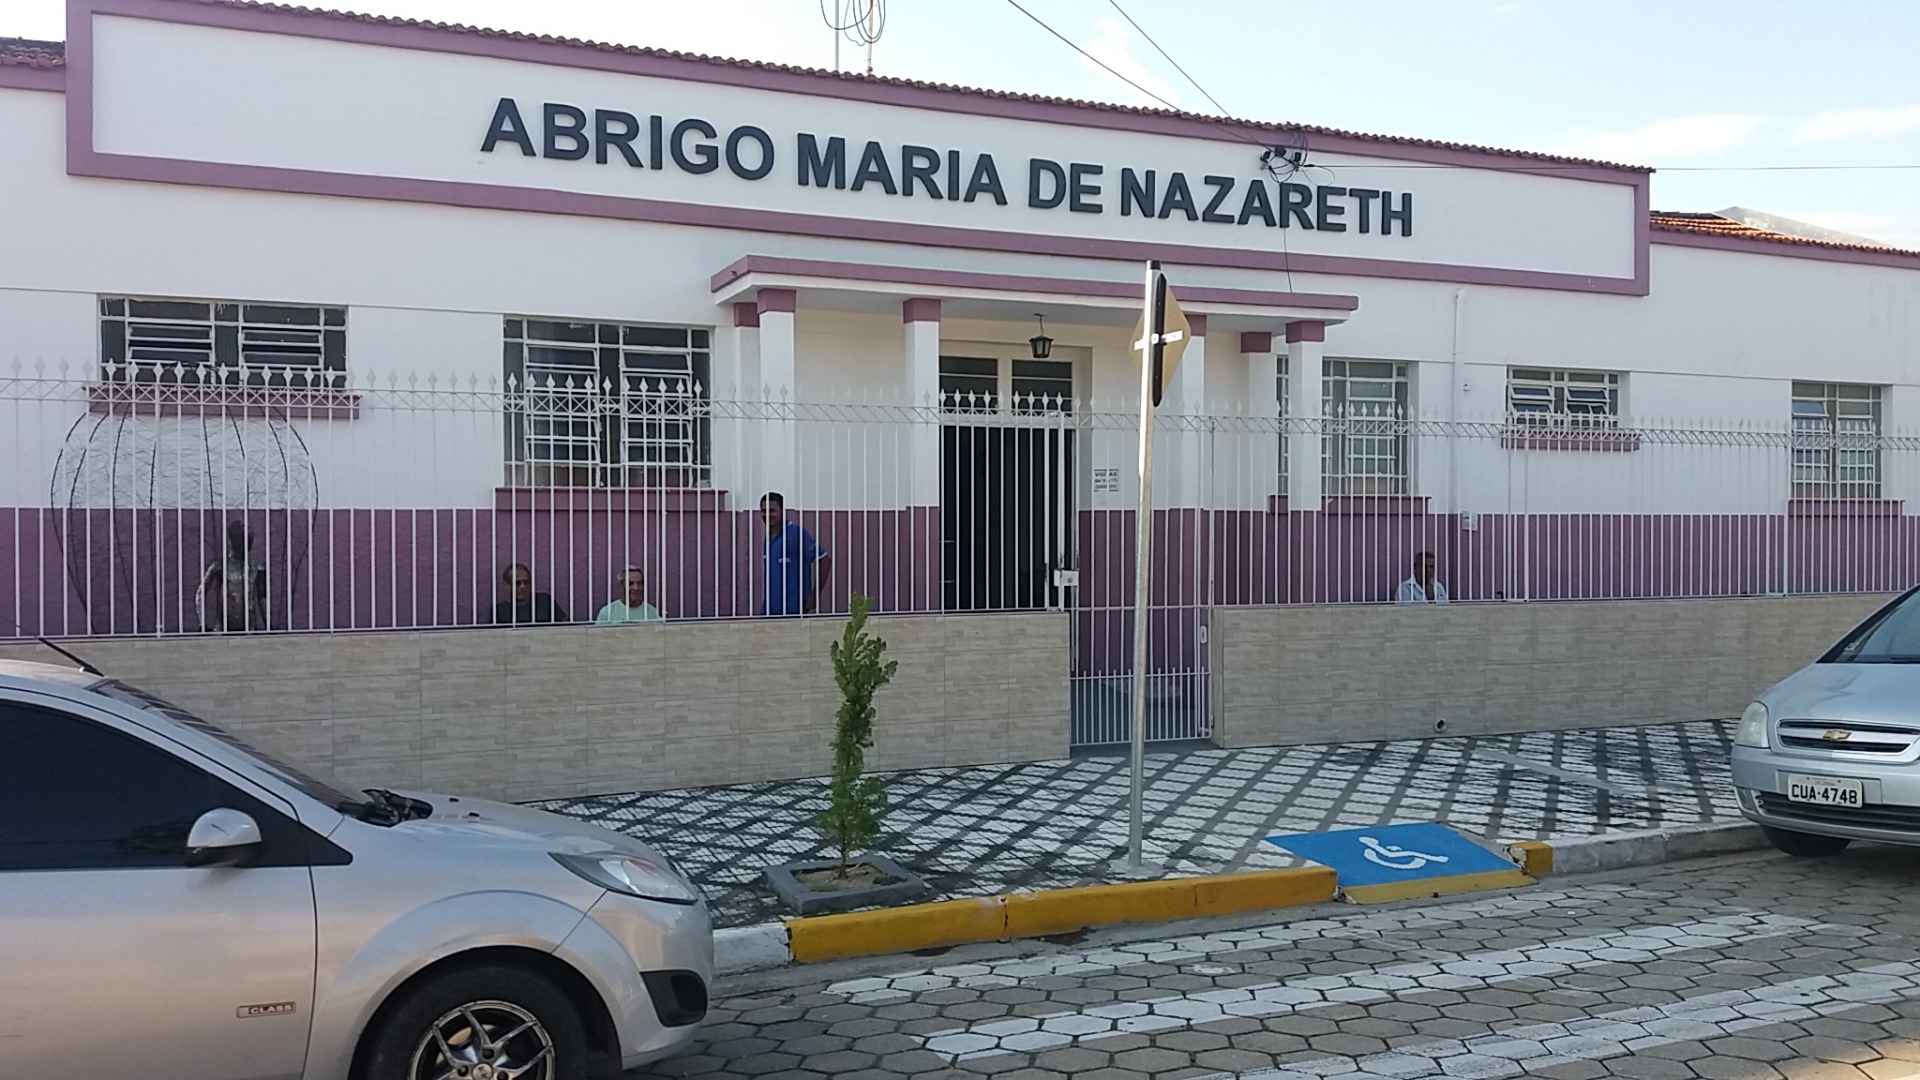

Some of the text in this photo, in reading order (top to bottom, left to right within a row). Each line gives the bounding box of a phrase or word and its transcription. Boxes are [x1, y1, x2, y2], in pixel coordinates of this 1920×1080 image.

[480, 97, 1413, 237] ABRIGO MARIA DE NAZARETH
[249, 1004, 292, 1014] CLASS
